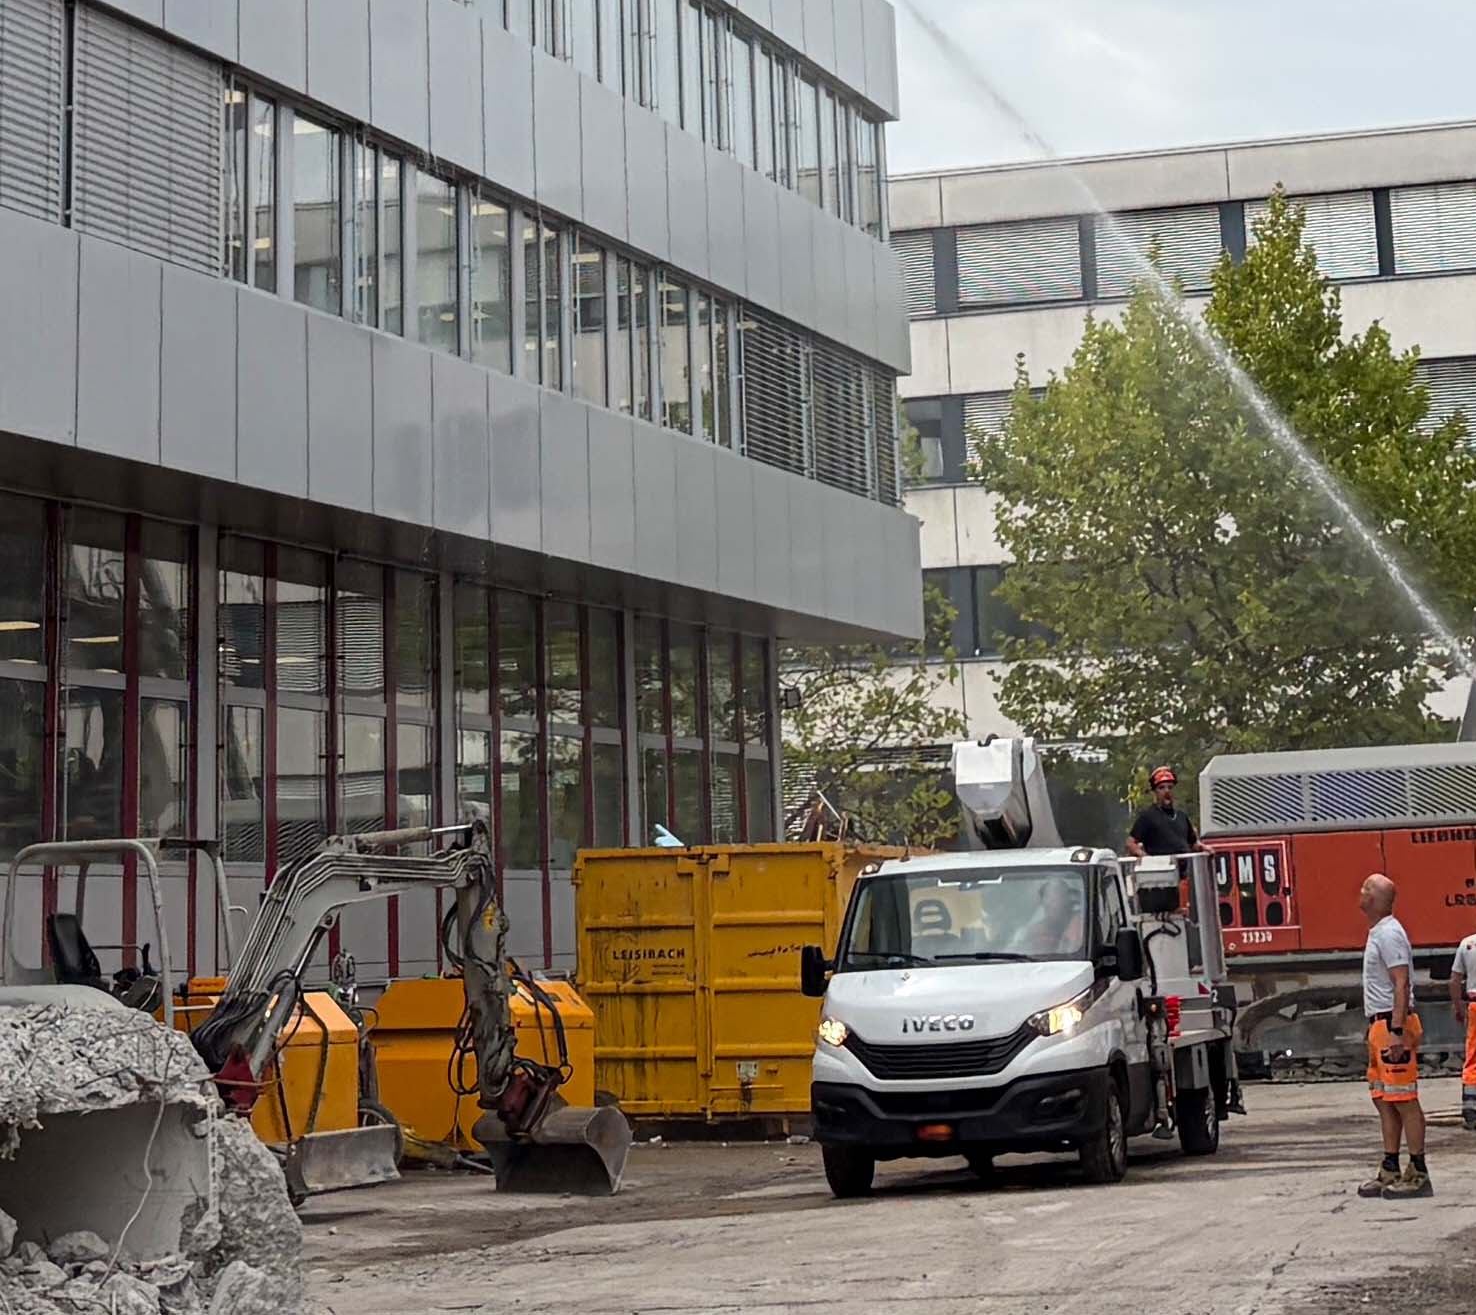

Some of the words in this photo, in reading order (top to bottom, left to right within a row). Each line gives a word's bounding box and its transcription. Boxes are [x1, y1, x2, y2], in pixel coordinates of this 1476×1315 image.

[1216, 854, 1276, 885] JMS
[612, 948, 686, 961] LEISIBACH
[902, 1014, 975, 1033] IVECO
